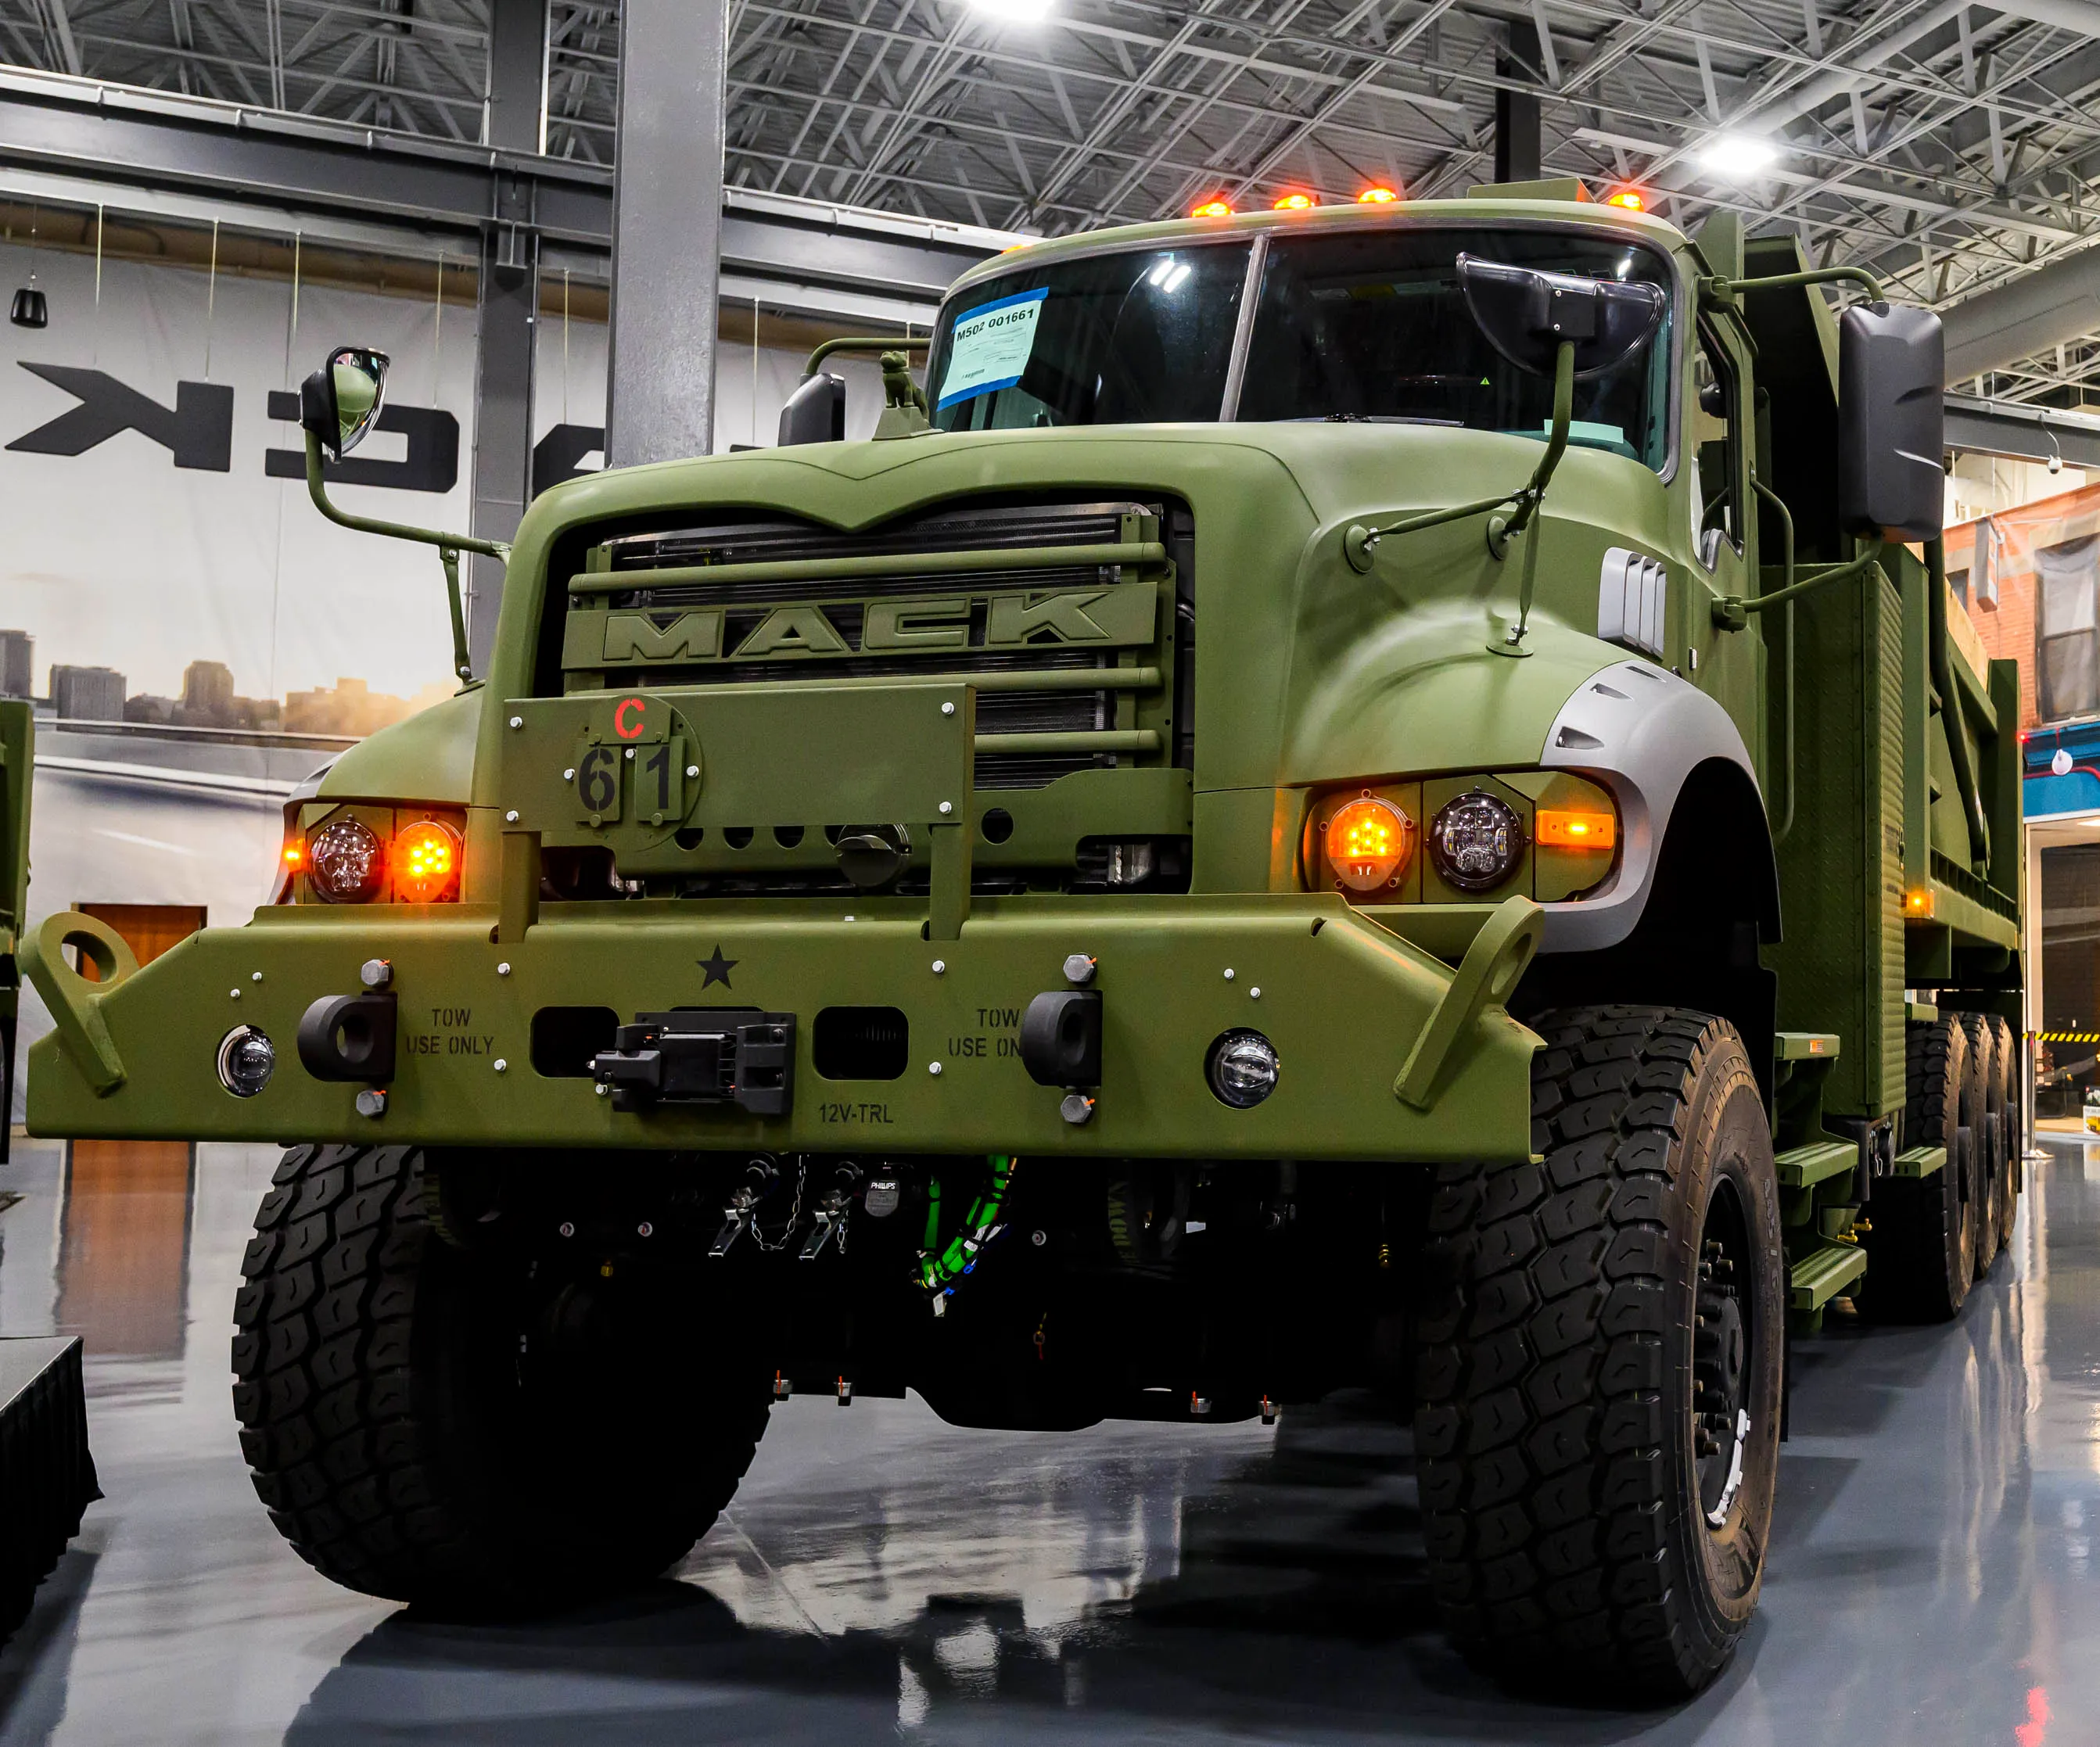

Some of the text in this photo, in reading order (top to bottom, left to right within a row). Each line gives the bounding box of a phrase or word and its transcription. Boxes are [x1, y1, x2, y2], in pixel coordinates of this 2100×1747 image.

[957, 322, 985, 341] M502
[989, 309, 1034, 328] 001661
[603, 591, 1113, 661] MACK
[614, 698, 645, 739] C
[579, 746, 670, 812] 61
[432, 1008, 471, 1026] TOW
[978, 1009, 1019, 1027] TOW
[407, 1035, 494, 1054] USE ONLY
[949, 1038, 1022, 1056] USE ON
[819, 1103, 893, 1123] 12V-TRL
